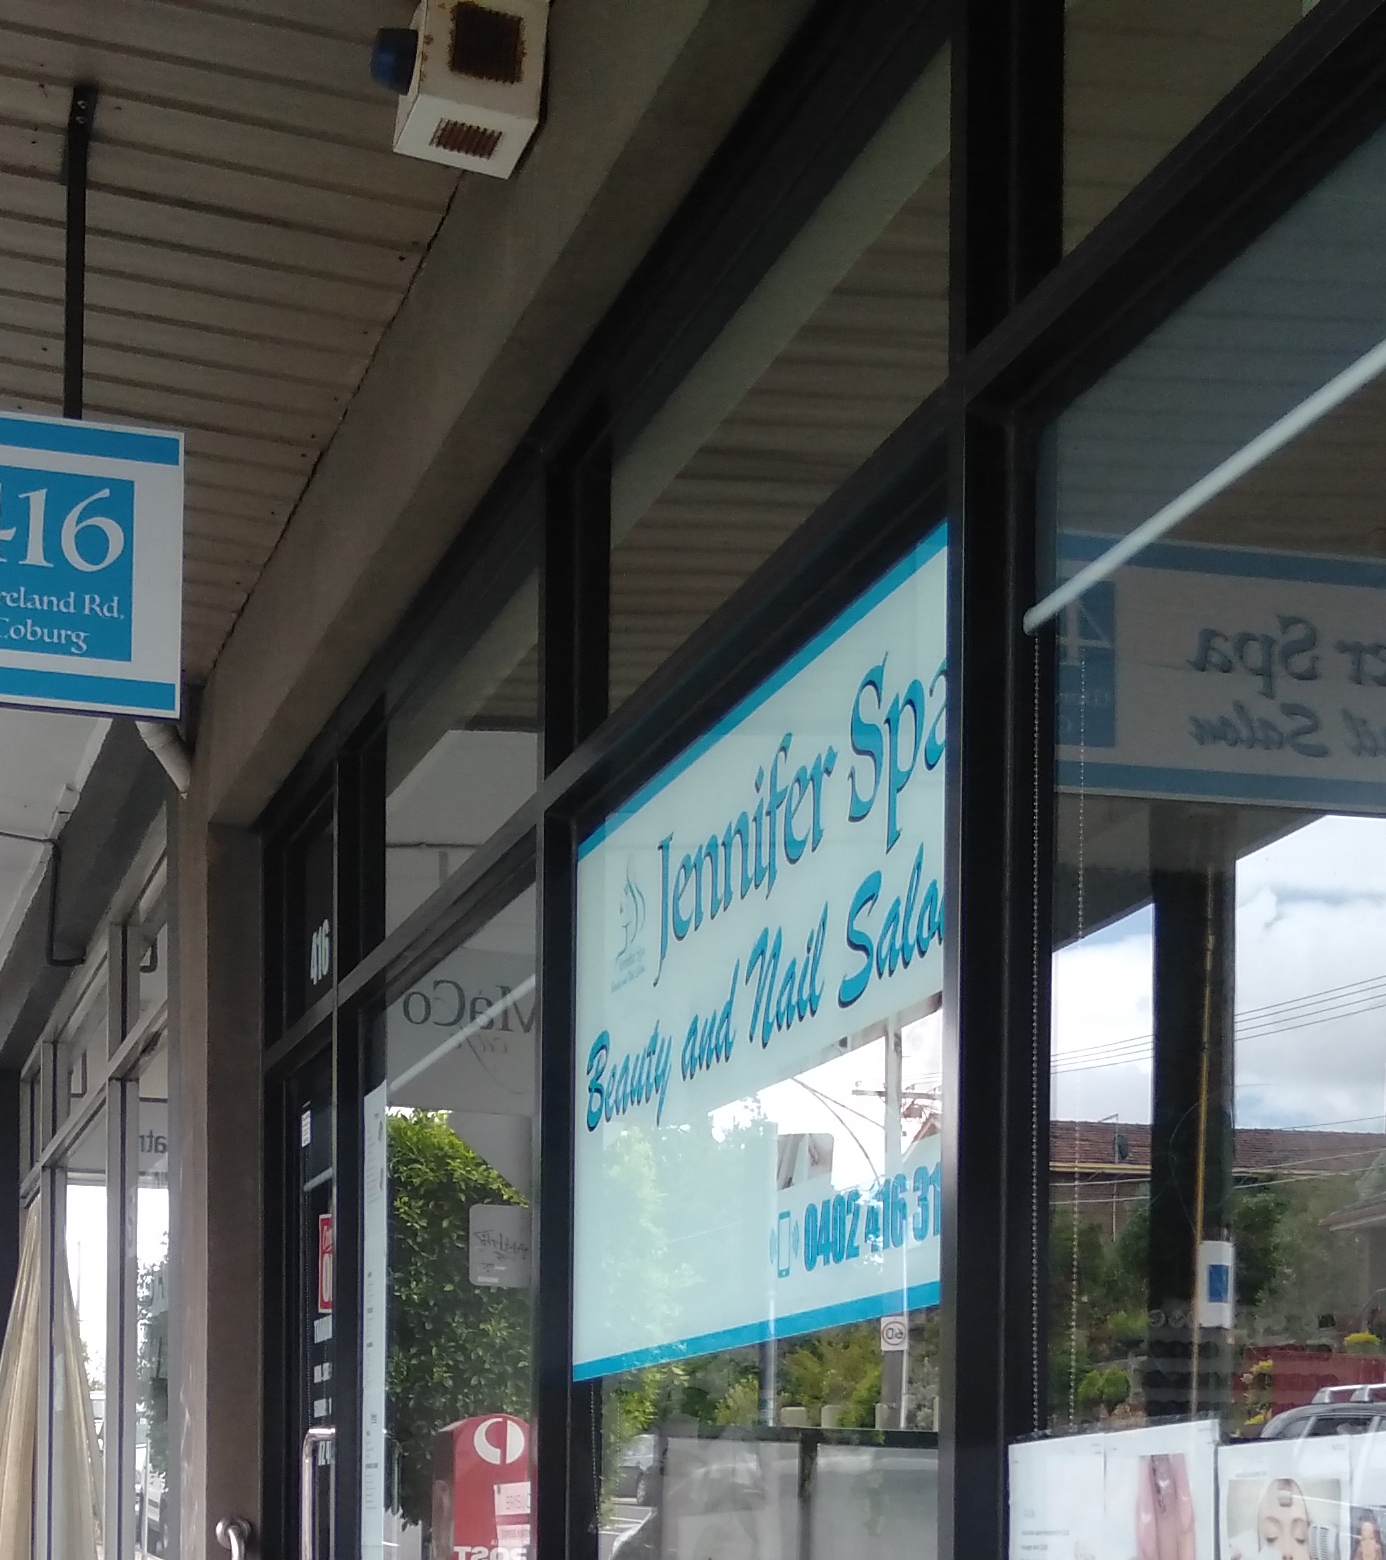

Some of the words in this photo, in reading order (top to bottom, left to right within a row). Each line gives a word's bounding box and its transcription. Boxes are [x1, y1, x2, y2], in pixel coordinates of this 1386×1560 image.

[653, 732, 838, 988] Jennifer
[586, 1018, 673, 1132] Beauty
[681, 958, 740, 1082] and
[745, 901, 828, 1050] Nail
[803, 1188, 861, 1272] 0402
